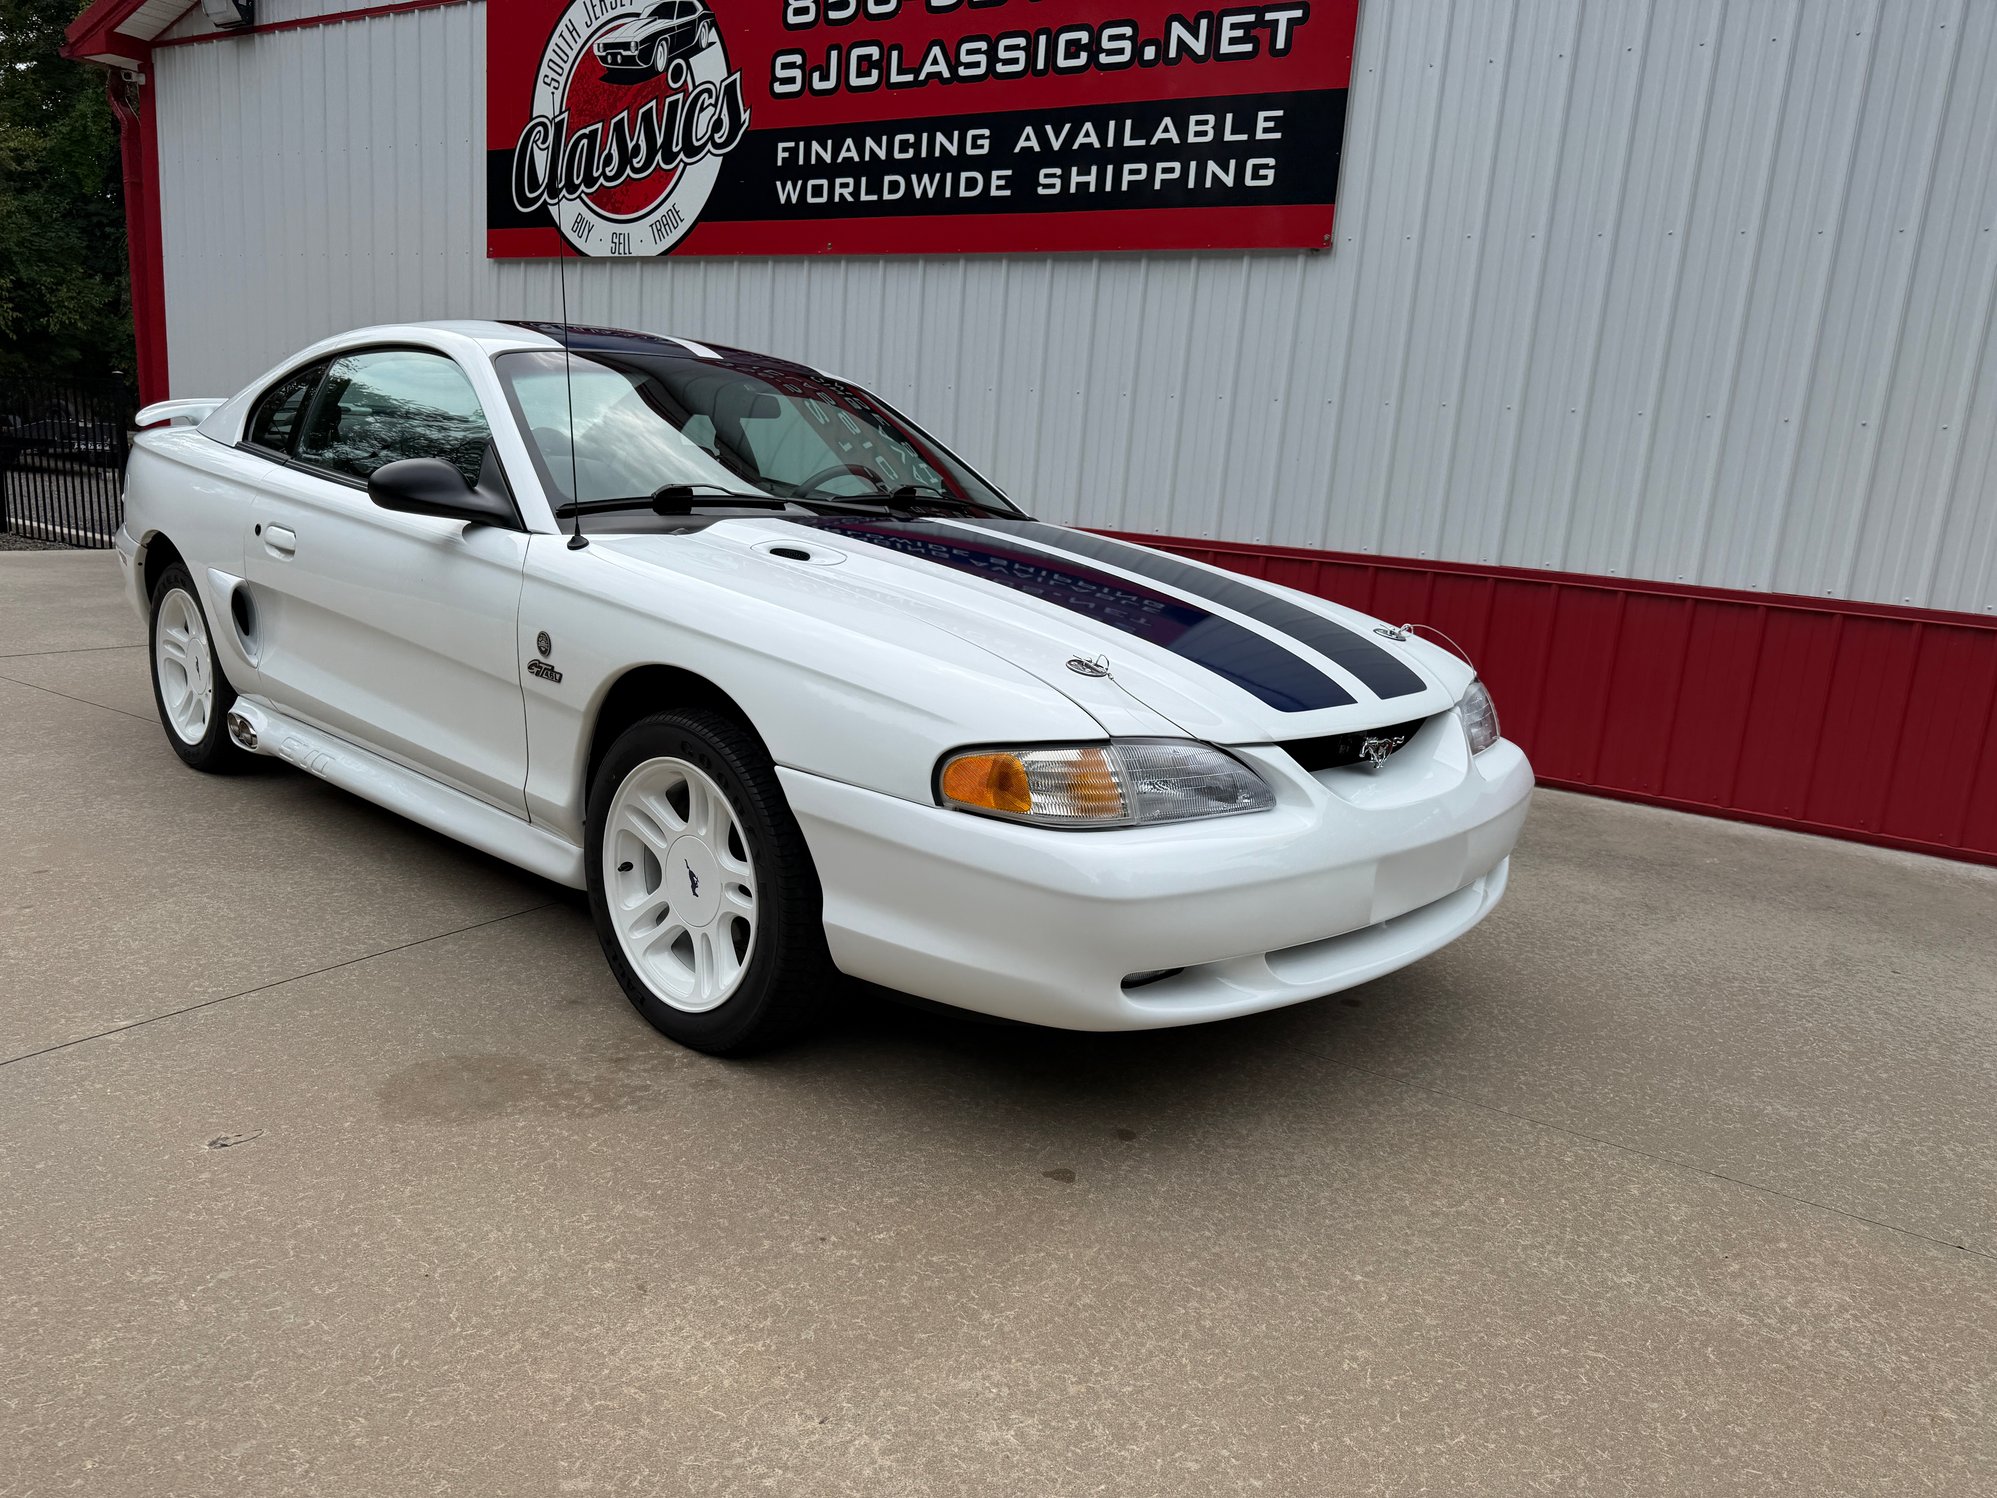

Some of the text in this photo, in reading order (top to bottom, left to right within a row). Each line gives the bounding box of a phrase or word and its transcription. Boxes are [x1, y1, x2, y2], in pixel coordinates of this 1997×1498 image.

[543, 18, 582, 91] SOUTH
[772, 8, 1304, 94] SJCLASSICS.NET
[512, 58, 751, 213] Classics
[776, 109, 1285, 167] FINANCING AVAILABLE
[775, 157, 1277, 205] WORLDWIDE SHIPPING
[570, 202, 686, 256] BUY SELL TRADE
